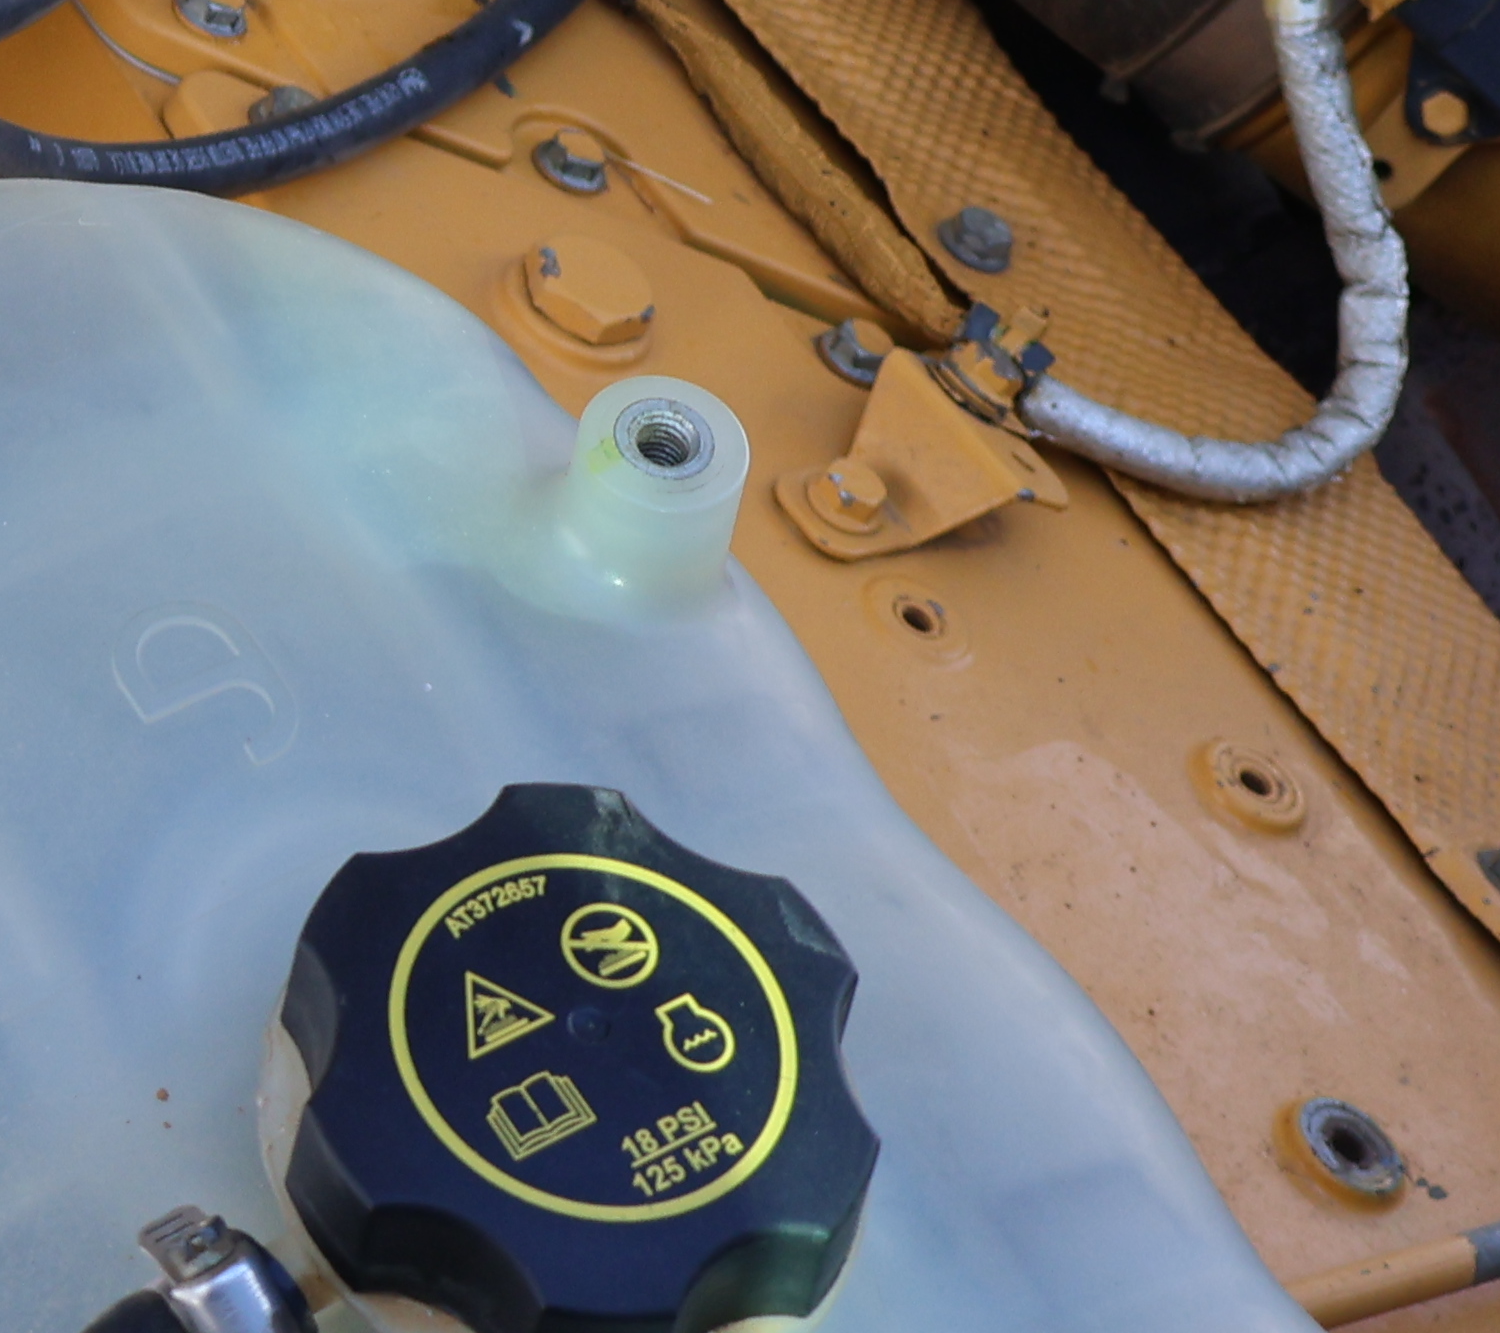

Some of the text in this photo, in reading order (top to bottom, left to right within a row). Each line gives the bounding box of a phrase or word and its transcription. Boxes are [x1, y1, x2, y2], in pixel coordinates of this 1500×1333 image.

[443, 874, 548, 940] AT372657
[620, 1100, 713, 1160] 18 PSI
[632, 1132, 745, 1197] 125 kPa
